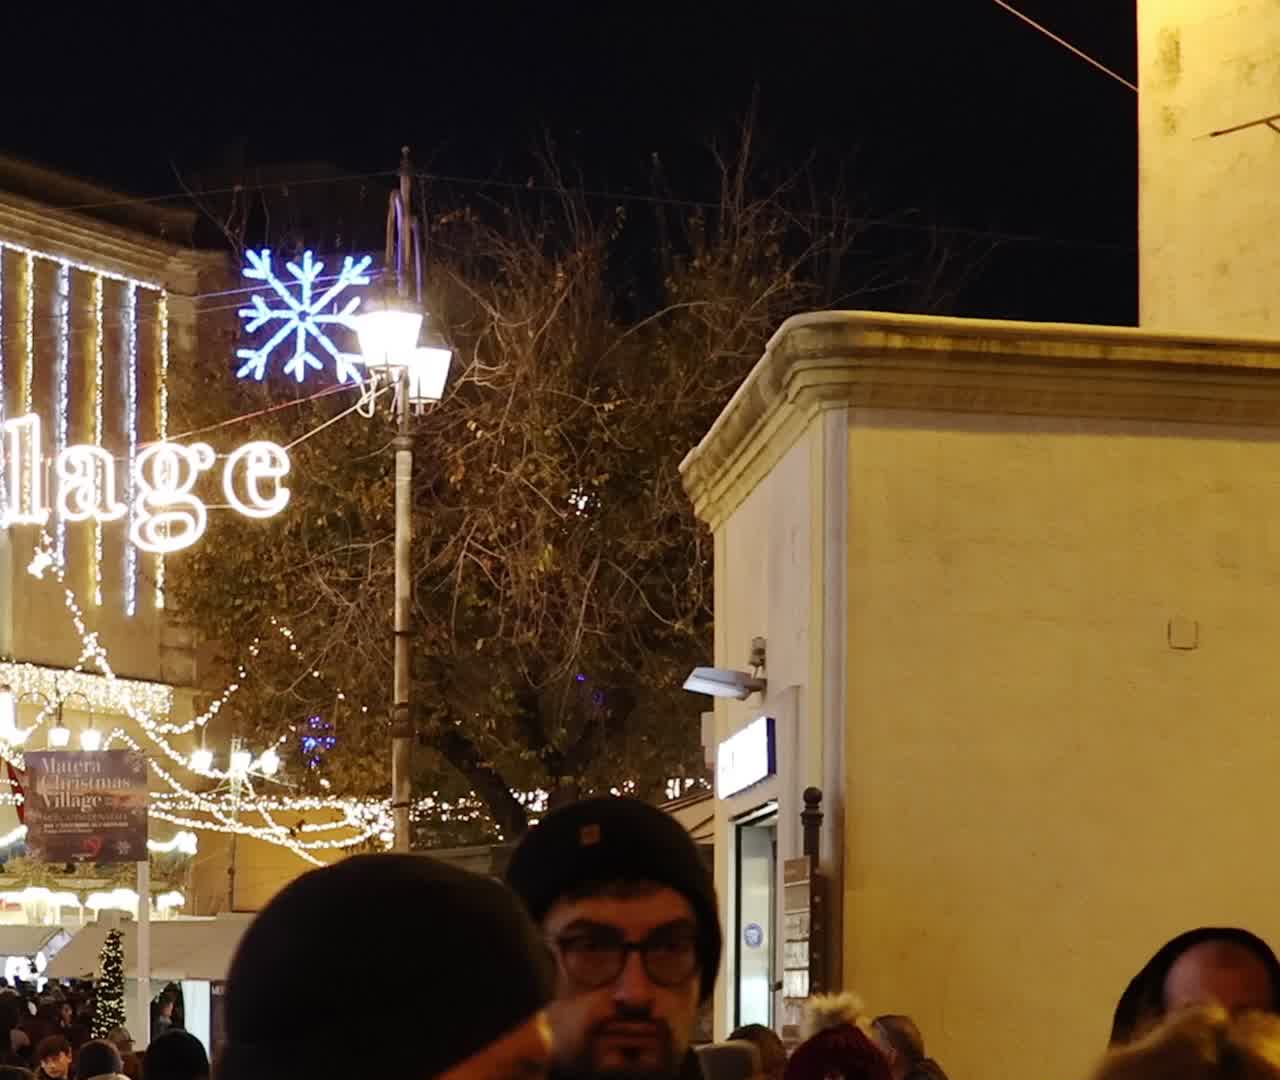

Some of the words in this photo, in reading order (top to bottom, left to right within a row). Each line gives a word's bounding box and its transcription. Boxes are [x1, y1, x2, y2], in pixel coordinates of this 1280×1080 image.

[41, 756, 101, 774] Matera
[37, 774, 131, 796] Christmas
[41, 791, 102, 813] Village
